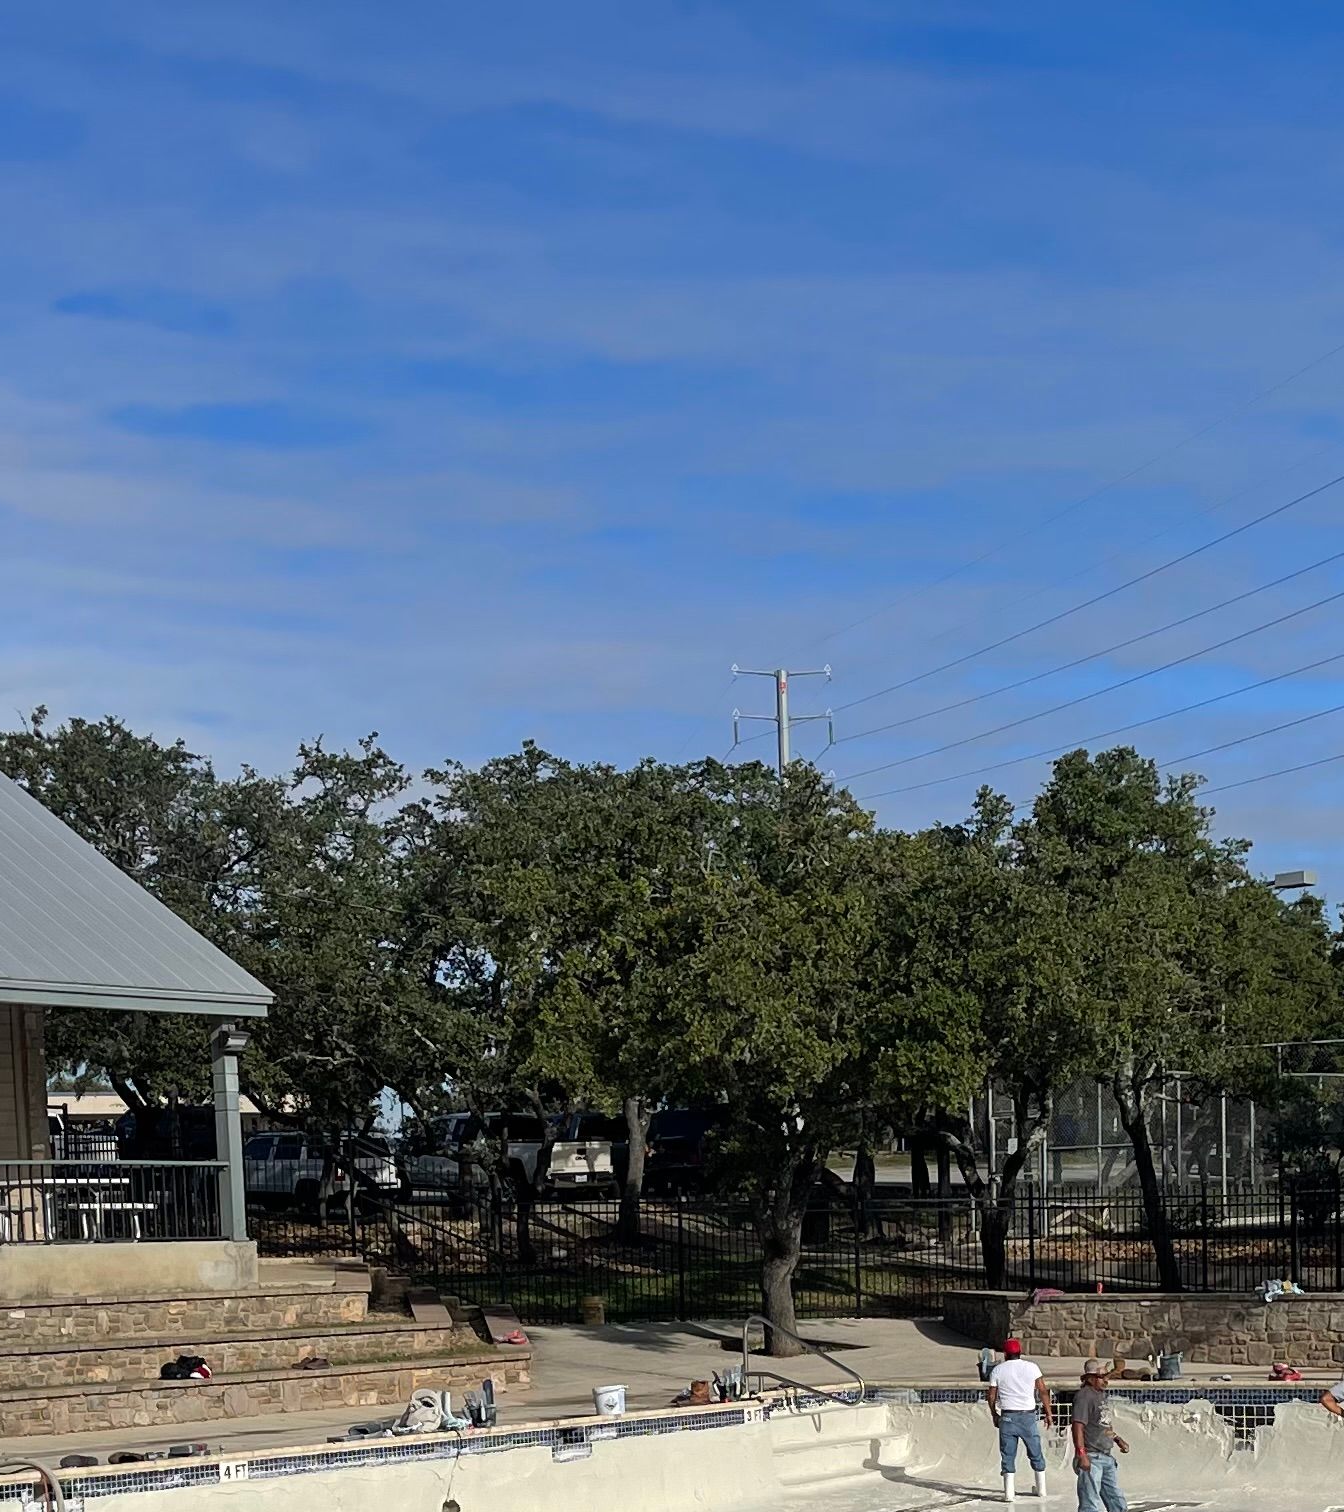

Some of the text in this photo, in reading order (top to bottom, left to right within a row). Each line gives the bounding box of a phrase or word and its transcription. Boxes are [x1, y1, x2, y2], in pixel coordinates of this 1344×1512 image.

[746, 1409, 762, 1421] 3 FT
[224, 1464, 246, 1479] 4 FT
